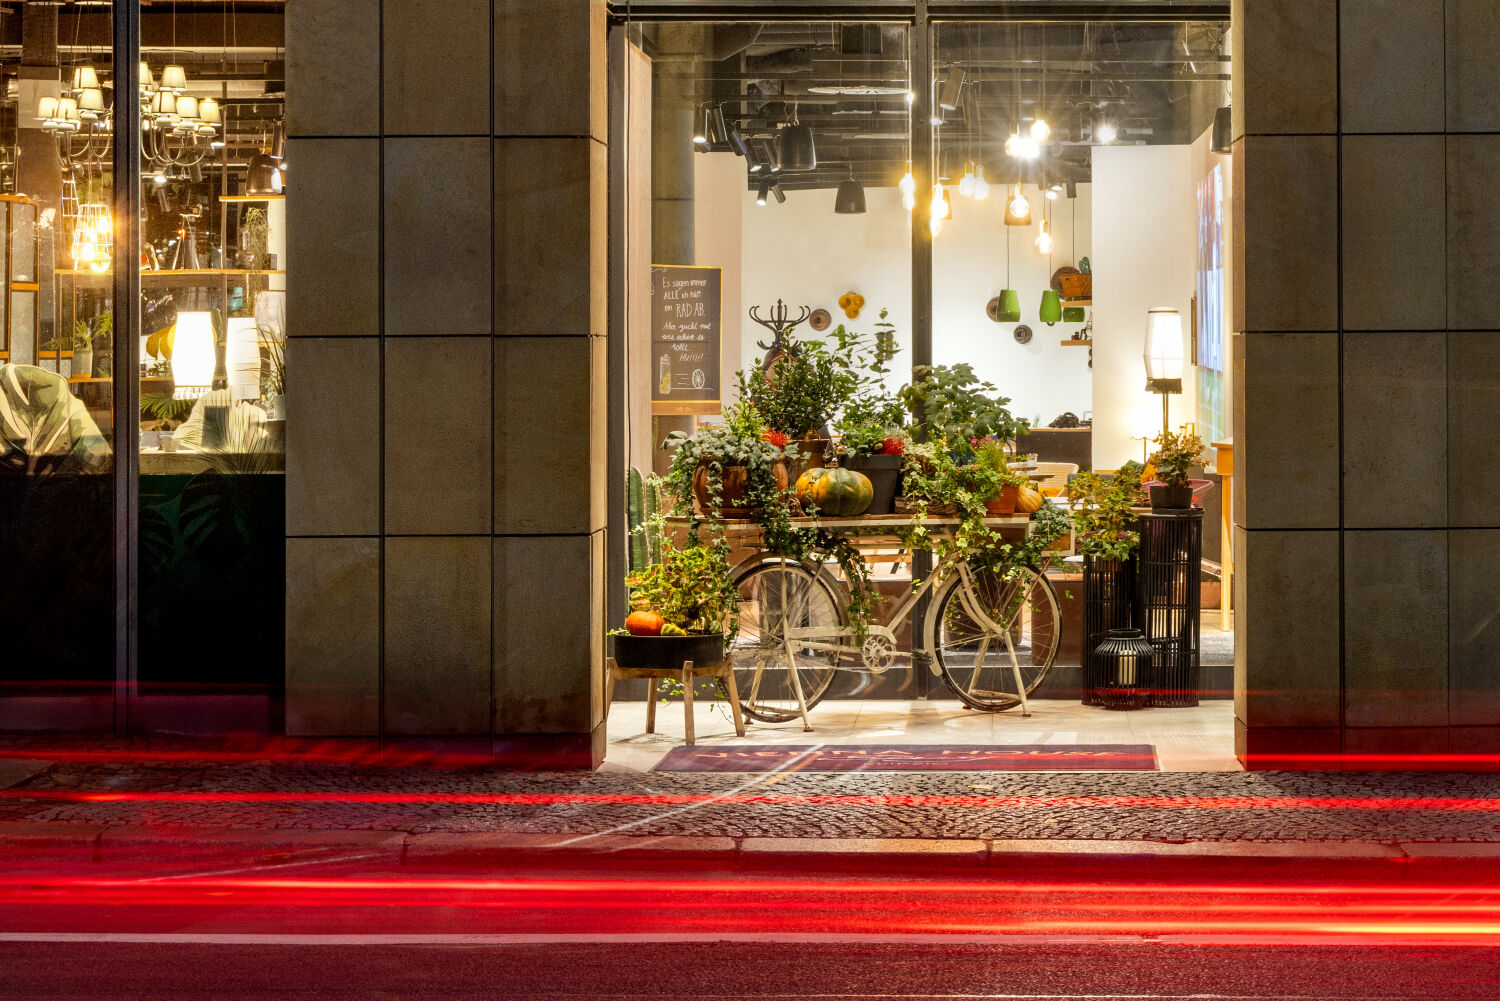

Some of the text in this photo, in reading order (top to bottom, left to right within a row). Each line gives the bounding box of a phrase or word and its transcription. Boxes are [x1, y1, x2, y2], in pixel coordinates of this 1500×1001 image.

[663, 277, 670, 288] Es
[672, 279, 689, 290] sagen
[664, 290, 680, 300] ALLE
[676, 302, 693, 318] RAD
[695, 750, 914, 758] VIENNA
